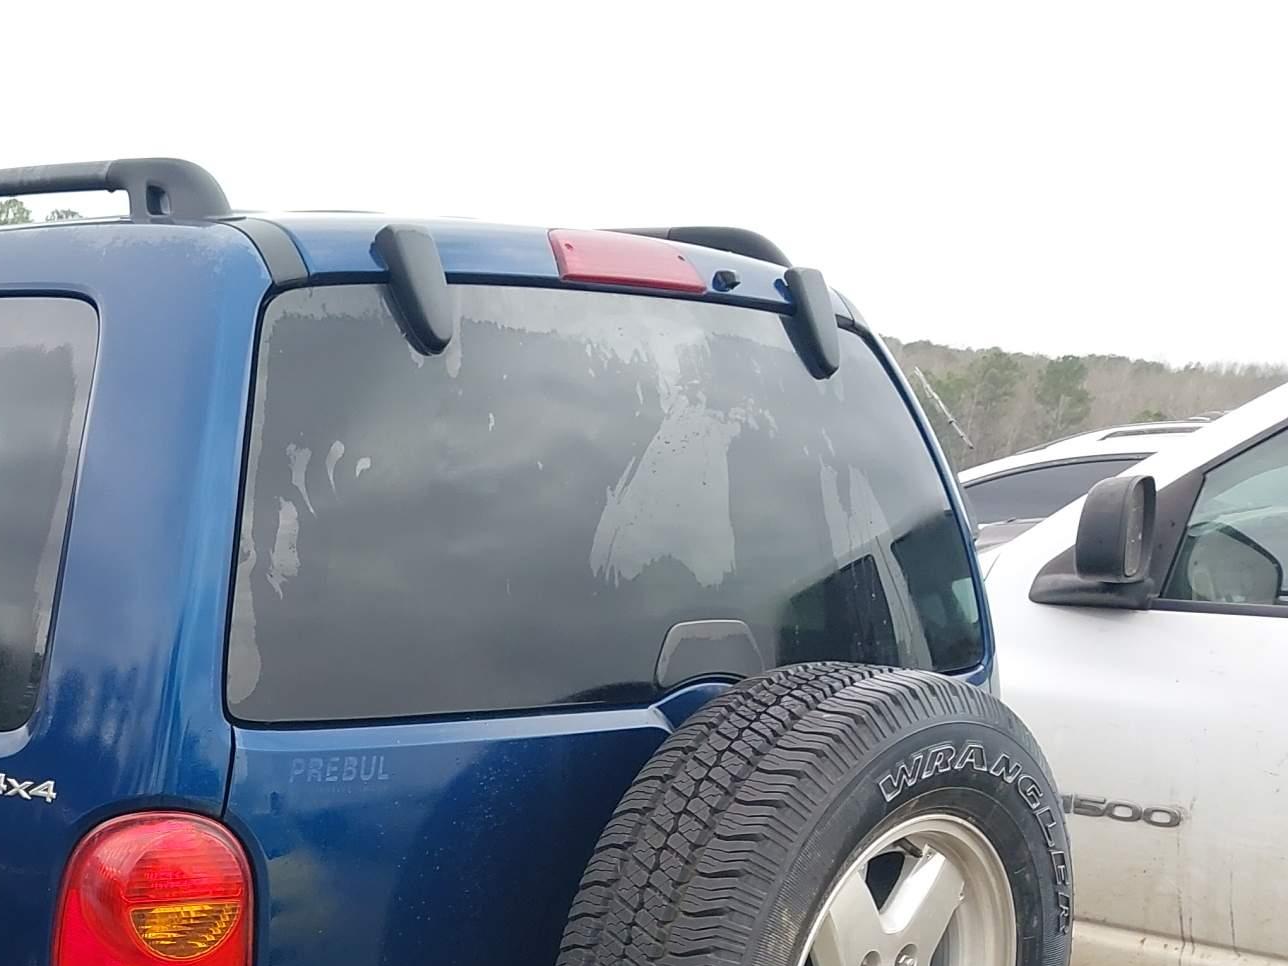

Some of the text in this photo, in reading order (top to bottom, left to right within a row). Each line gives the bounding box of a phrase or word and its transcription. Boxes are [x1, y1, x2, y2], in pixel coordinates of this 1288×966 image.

[289, 754, 390, 783] PREBUL
[1060, 792, 1182, 828] 1500
[877, 742, 1071, 935] WRANGLER
